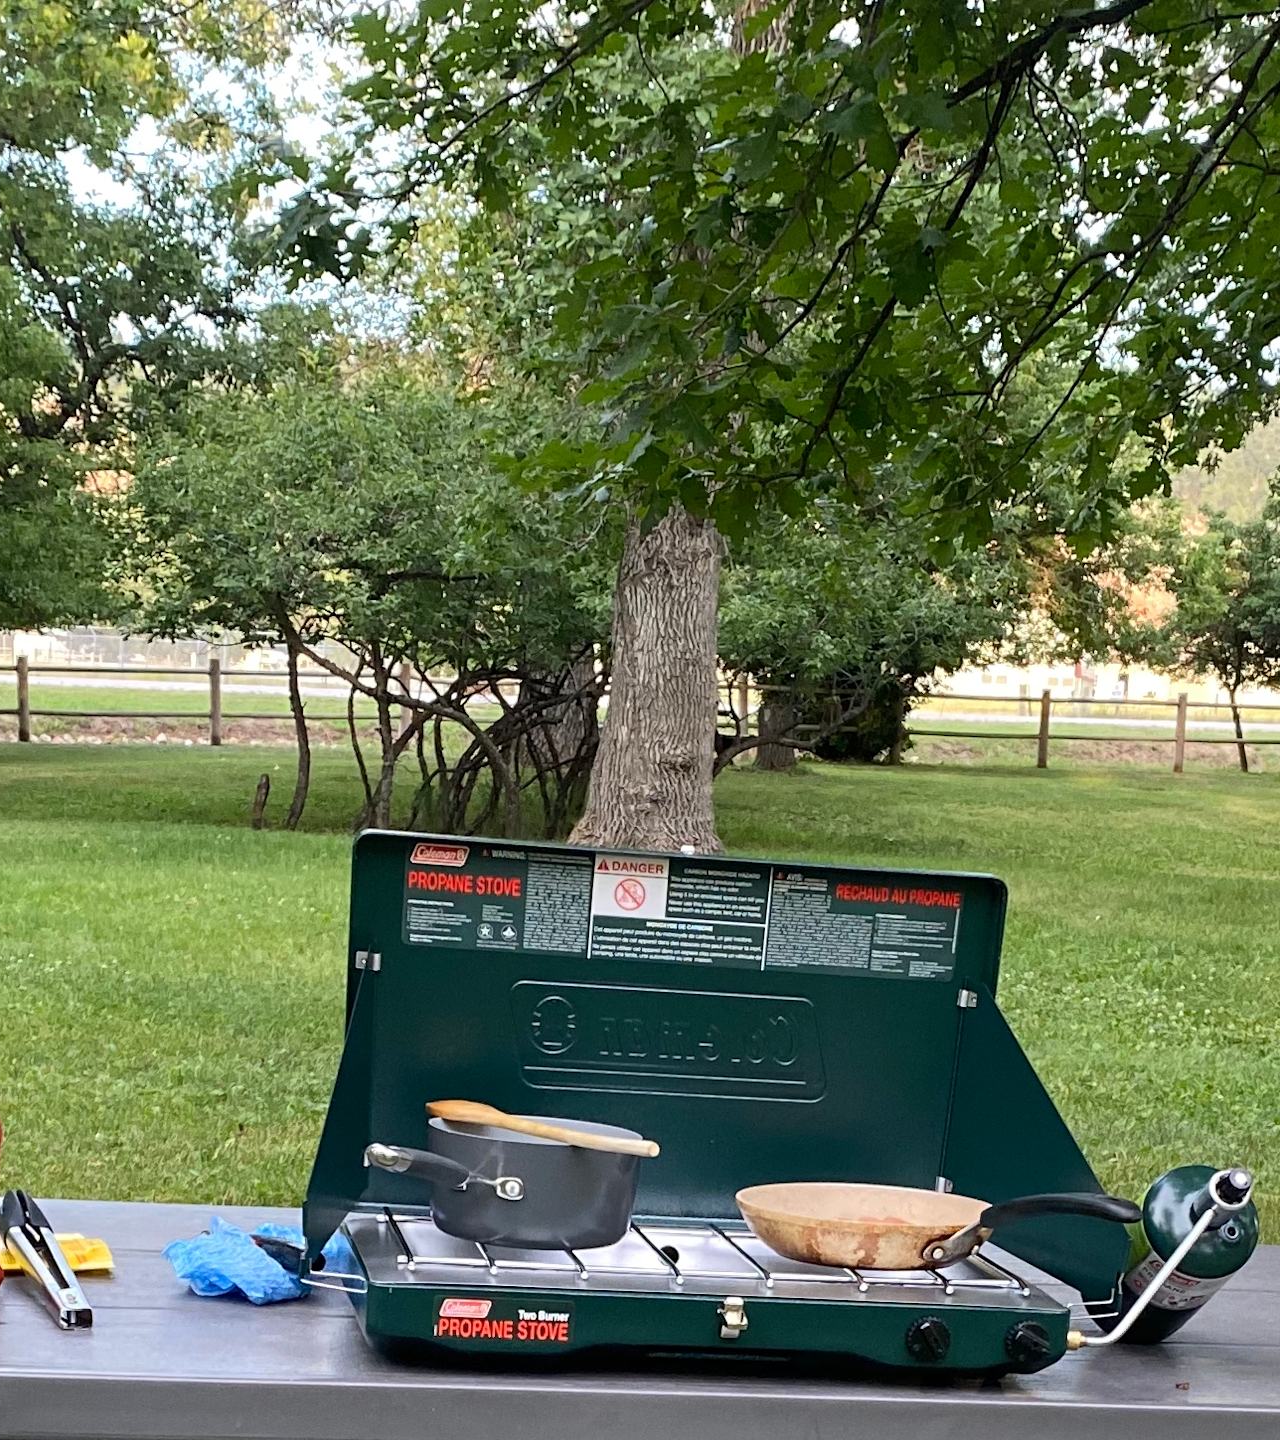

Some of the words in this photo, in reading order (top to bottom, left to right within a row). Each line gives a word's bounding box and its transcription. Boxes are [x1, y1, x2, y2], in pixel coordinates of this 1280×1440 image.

[416, 846, 458, 861] Coleman
[612, 861, 664, 874] DANGER
[408, 871, 473, 893] PROPANE
[476, 877, 521, 897] STOVE
[891, 887, 908, 904] AU
[909, 889, 961, 908] PROPANE
[518, 1309, 537, 1320] Two
[538, 1310, 570, 1322] Burner
[438, 1318, 513, 1339] PROPANE
[517, 1321, 569, 1341] STOVE
